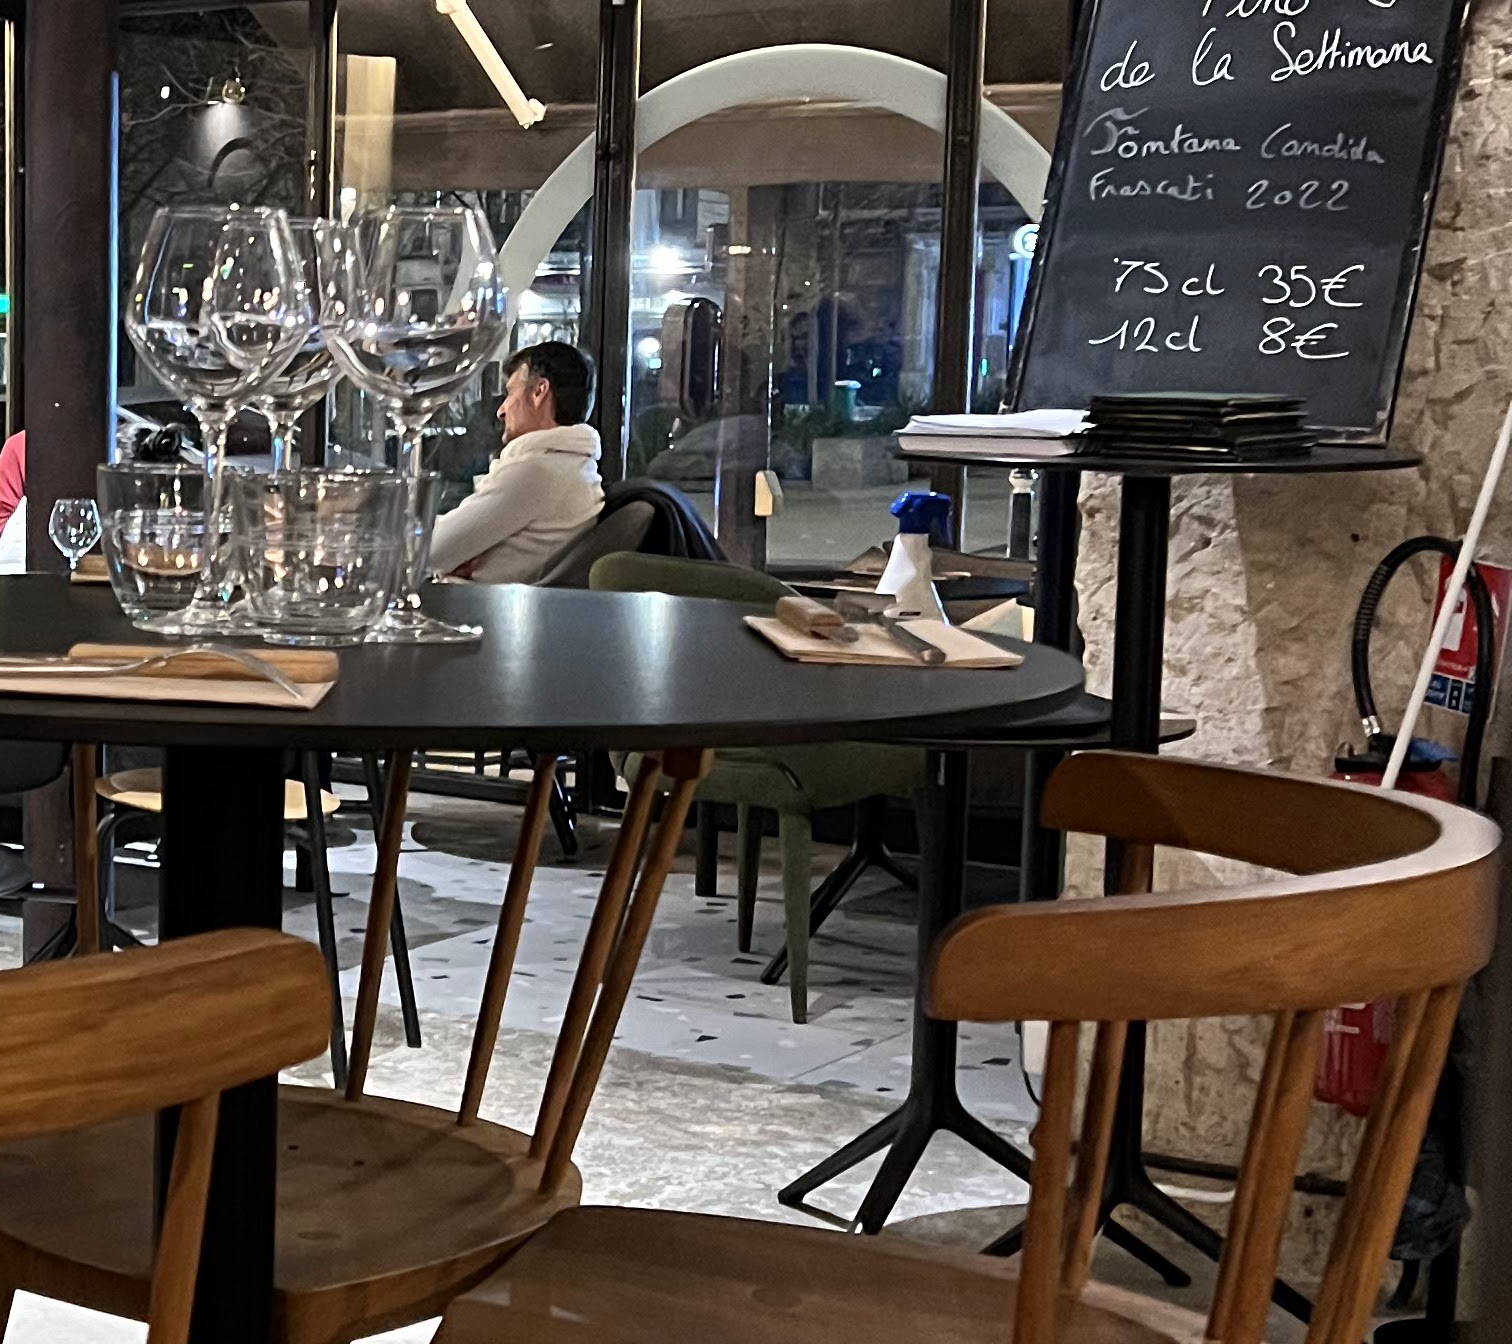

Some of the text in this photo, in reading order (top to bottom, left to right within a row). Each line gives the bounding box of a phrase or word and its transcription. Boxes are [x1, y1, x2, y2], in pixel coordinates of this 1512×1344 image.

[1100, 22, 1434, 92] de la Settimana
[1261, 124, 1385, 164] Candida
[1089, 167, 1350, 211] Frascati 2022
